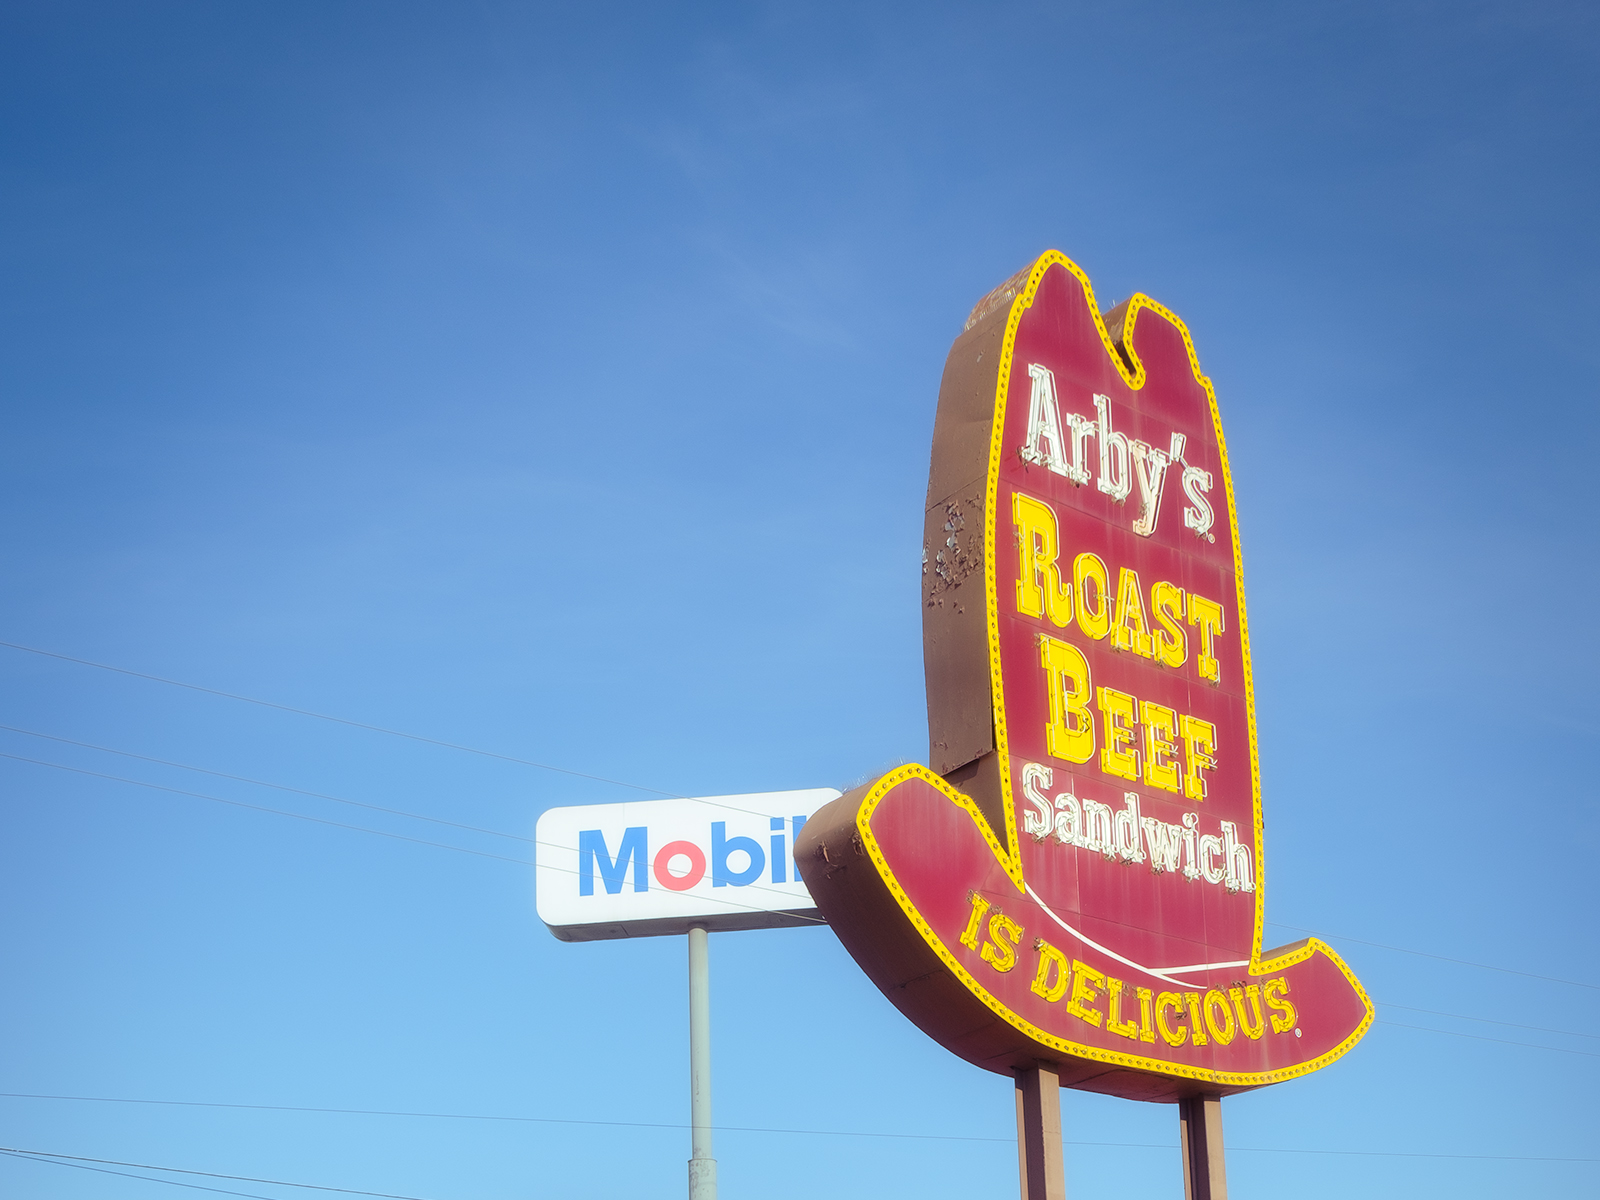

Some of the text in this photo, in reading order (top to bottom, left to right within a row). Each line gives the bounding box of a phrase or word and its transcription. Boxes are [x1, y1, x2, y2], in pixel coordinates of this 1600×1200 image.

[1021, 363, 1214, 537] Arby's
[1012, 492, 1224, 682] ROAST
[1040, 634, 1217, 800] BEEF
[579, 816, 806, 896] Mobil
[1023, 763, 1255, 893] Sandwich
[960, 891, 1297, 1046] IS DELICIOUS
